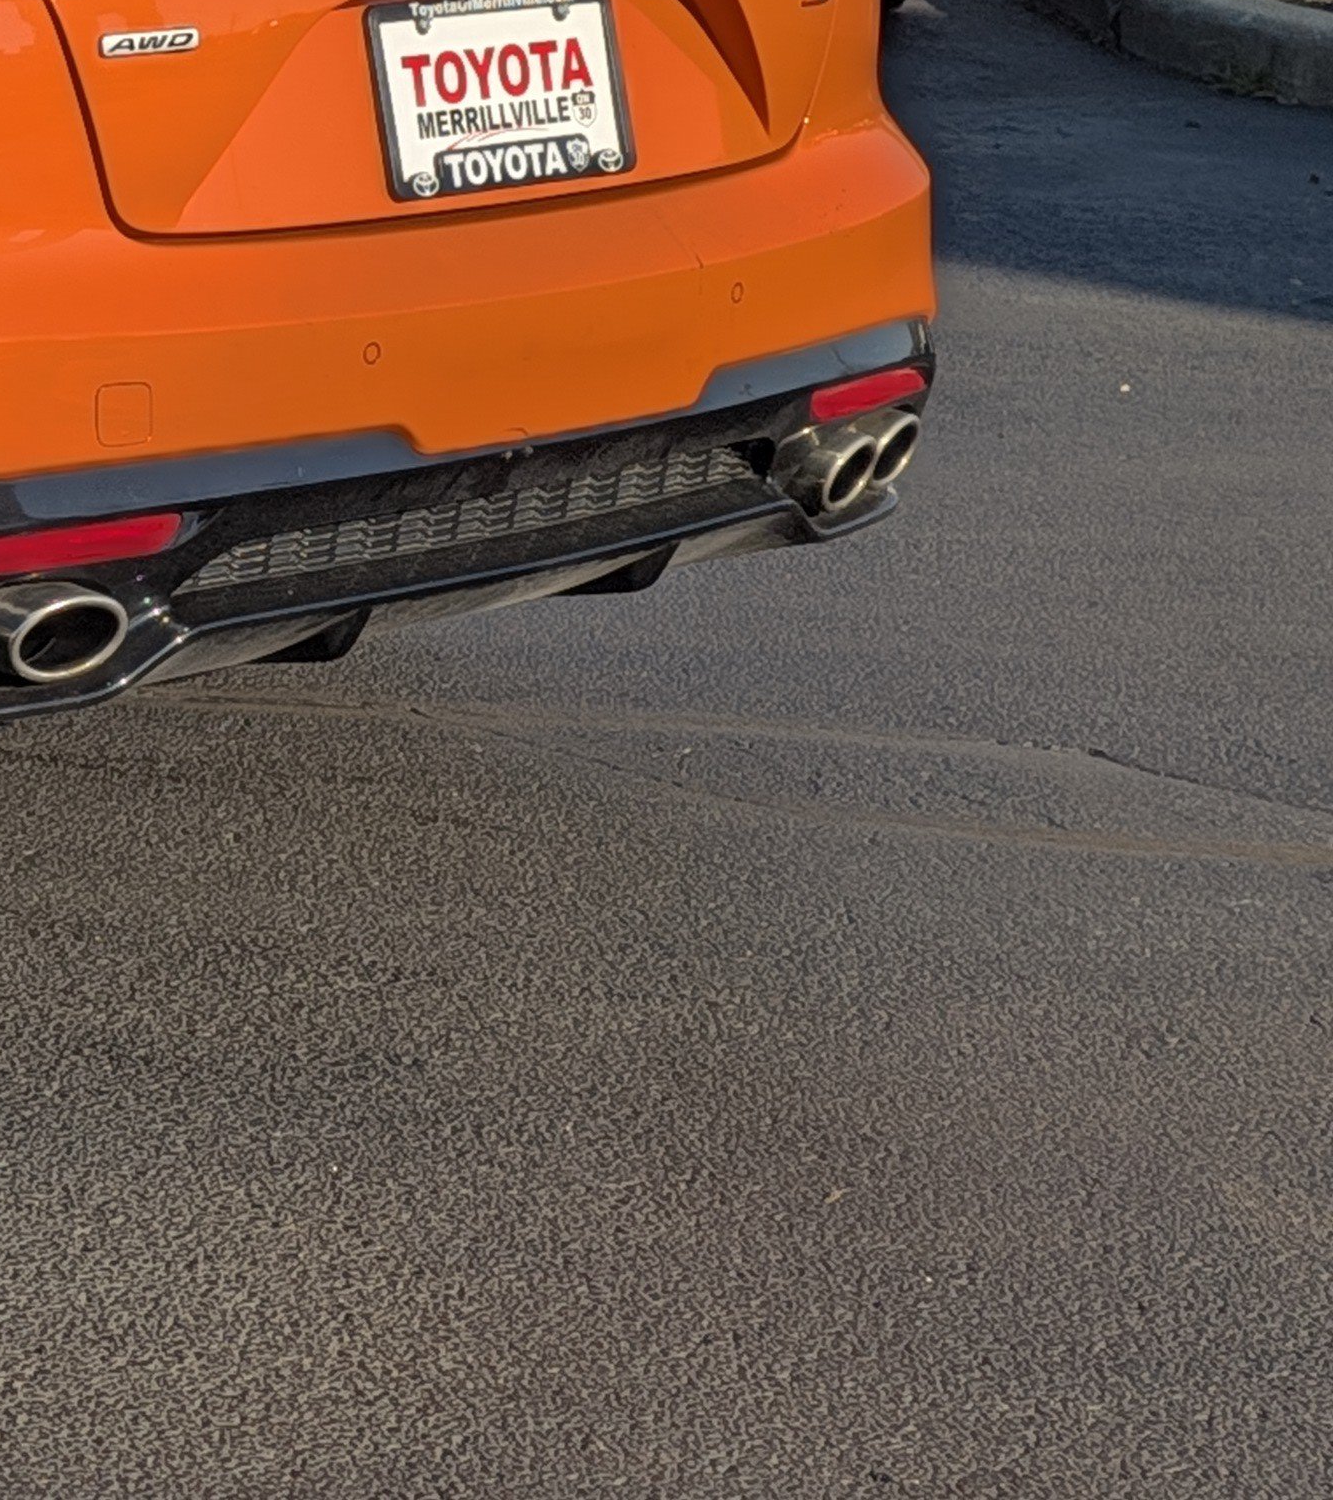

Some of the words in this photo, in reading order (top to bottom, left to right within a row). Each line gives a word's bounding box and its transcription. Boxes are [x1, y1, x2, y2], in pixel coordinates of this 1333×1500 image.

[107, 32, 194, 53] AWD
[400, 37, 594, 107] TOYOTA
[416, 96, 571, 140] MERRILLVILLE
[443, 141, 568, 189] TOYOTA
